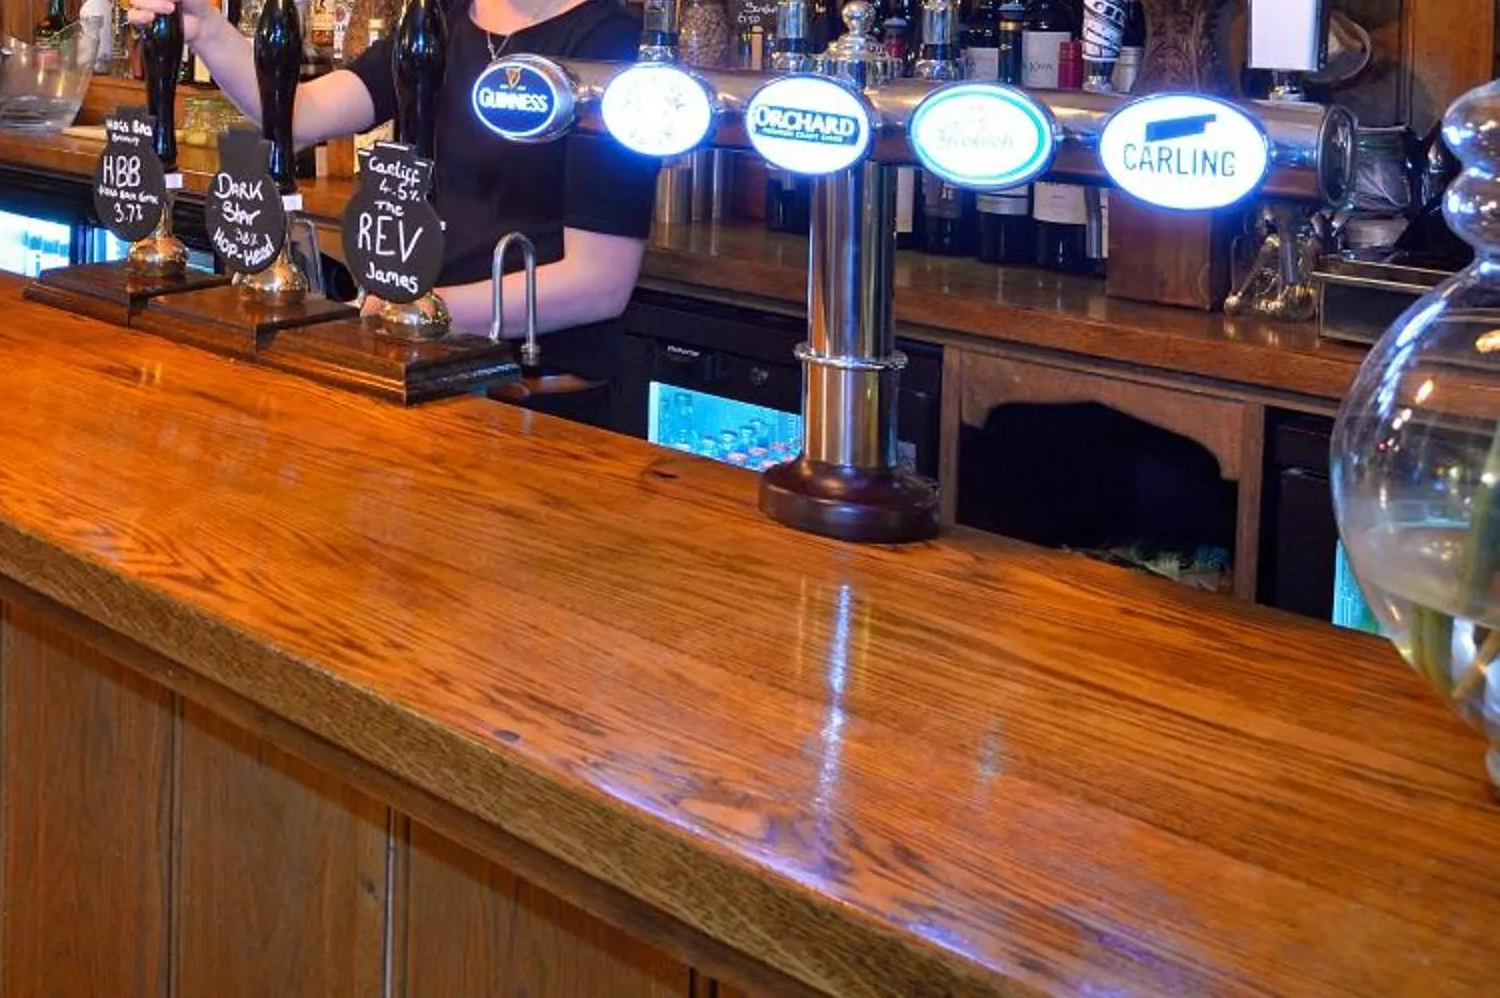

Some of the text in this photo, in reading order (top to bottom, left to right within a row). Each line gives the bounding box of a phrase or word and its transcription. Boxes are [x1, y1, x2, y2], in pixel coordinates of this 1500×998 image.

[479, 87, 549, 113] GUINNESS
[755, 104, 856, 138] ORCHARD
[102, 155, 141, 188] HBB
[1122, 143, 1236, 177] CARLING
[357, 211, 424, 264] REV
[365, 261, 420, 296] James
